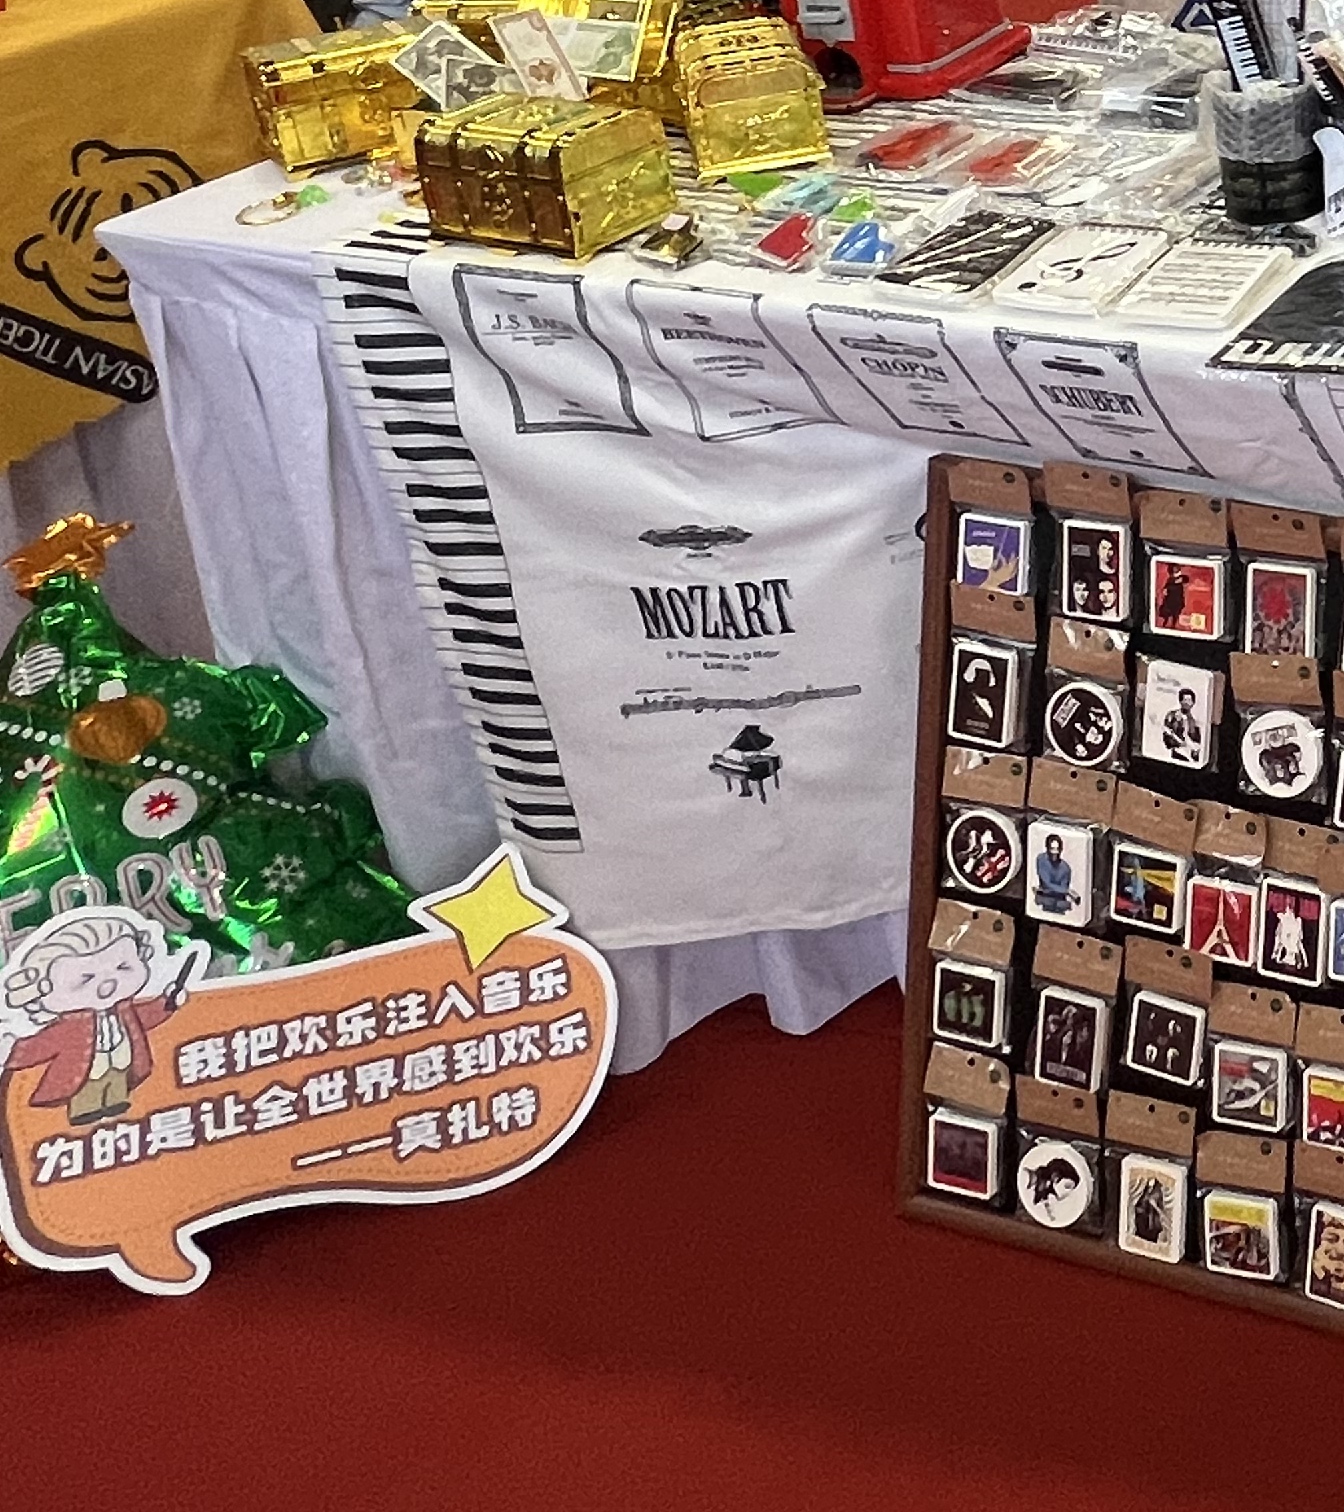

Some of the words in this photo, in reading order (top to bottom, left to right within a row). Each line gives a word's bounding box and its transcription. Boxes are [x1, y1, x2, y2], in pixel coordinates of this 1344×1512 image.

[630, 578, 797, 640] MOZART
[176, 954, 571, 1086] 我把欢乐注入音乐
[33, 1011, 592, 1184] 为的是让全世界感到欢乐
